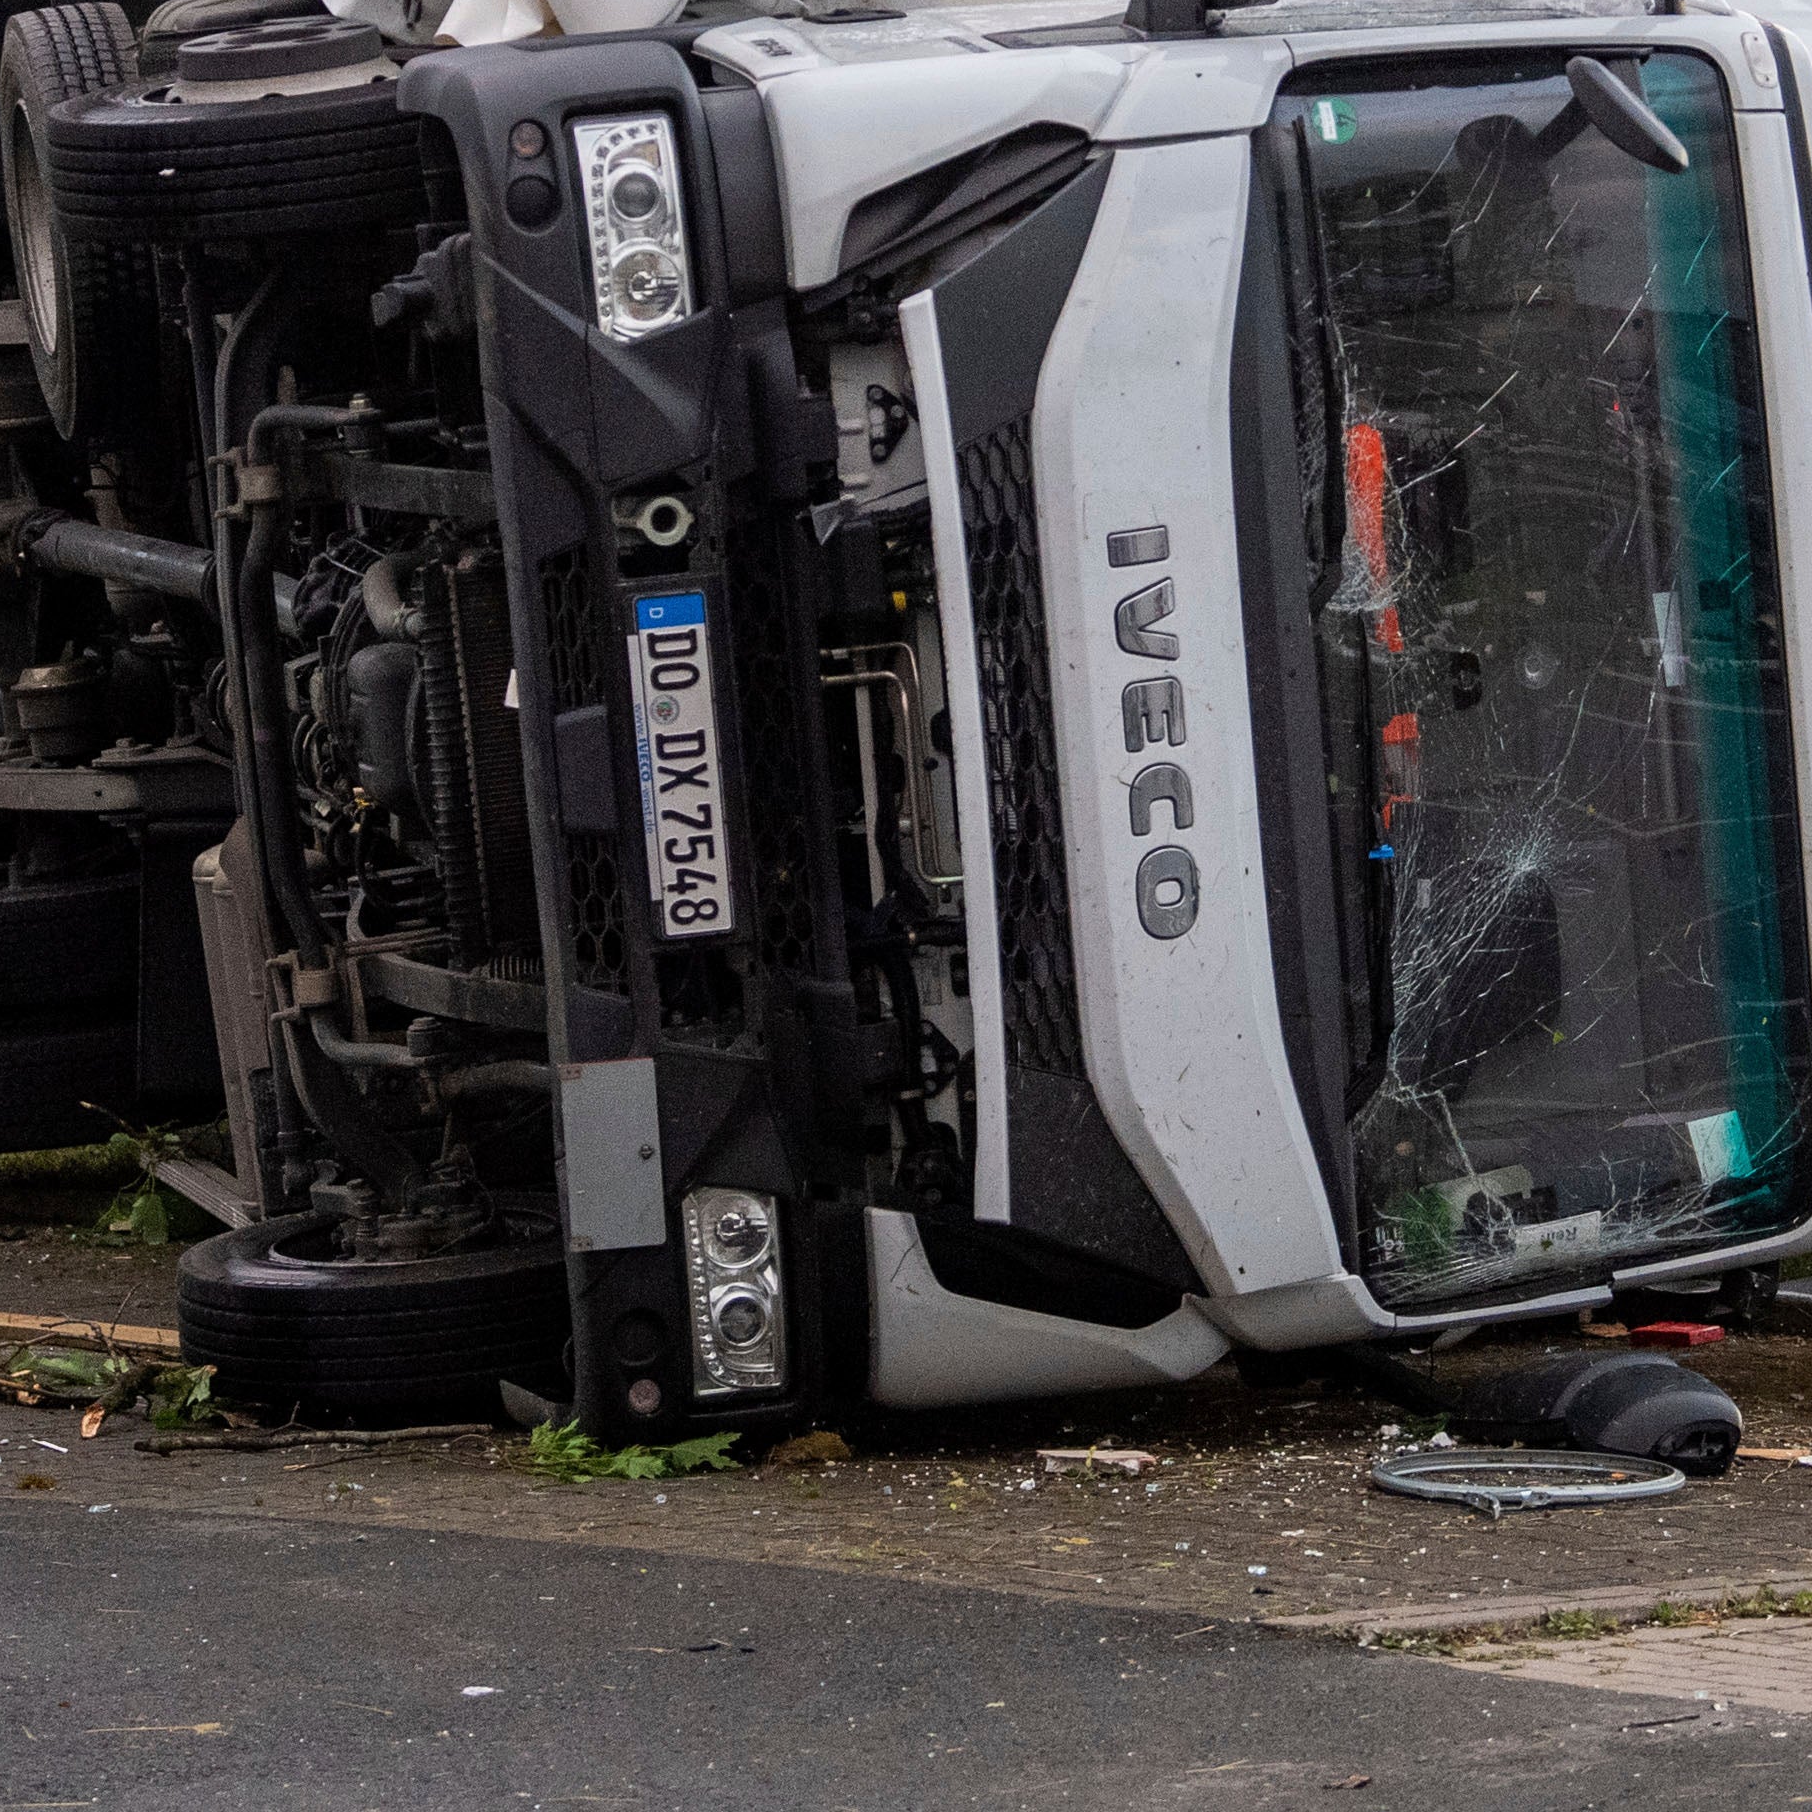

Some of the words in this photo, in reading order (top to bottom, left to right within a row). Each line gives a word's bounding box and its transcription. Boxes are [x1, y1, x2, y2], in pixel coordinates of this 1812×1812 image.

[648, 606, 665, 619] D
[646, 628, 700, 692] DO
[655, 728, 710, 795] DX
[1107, 525, 1200, 941] IVECO
[661, 803, 720, 927] 7548
